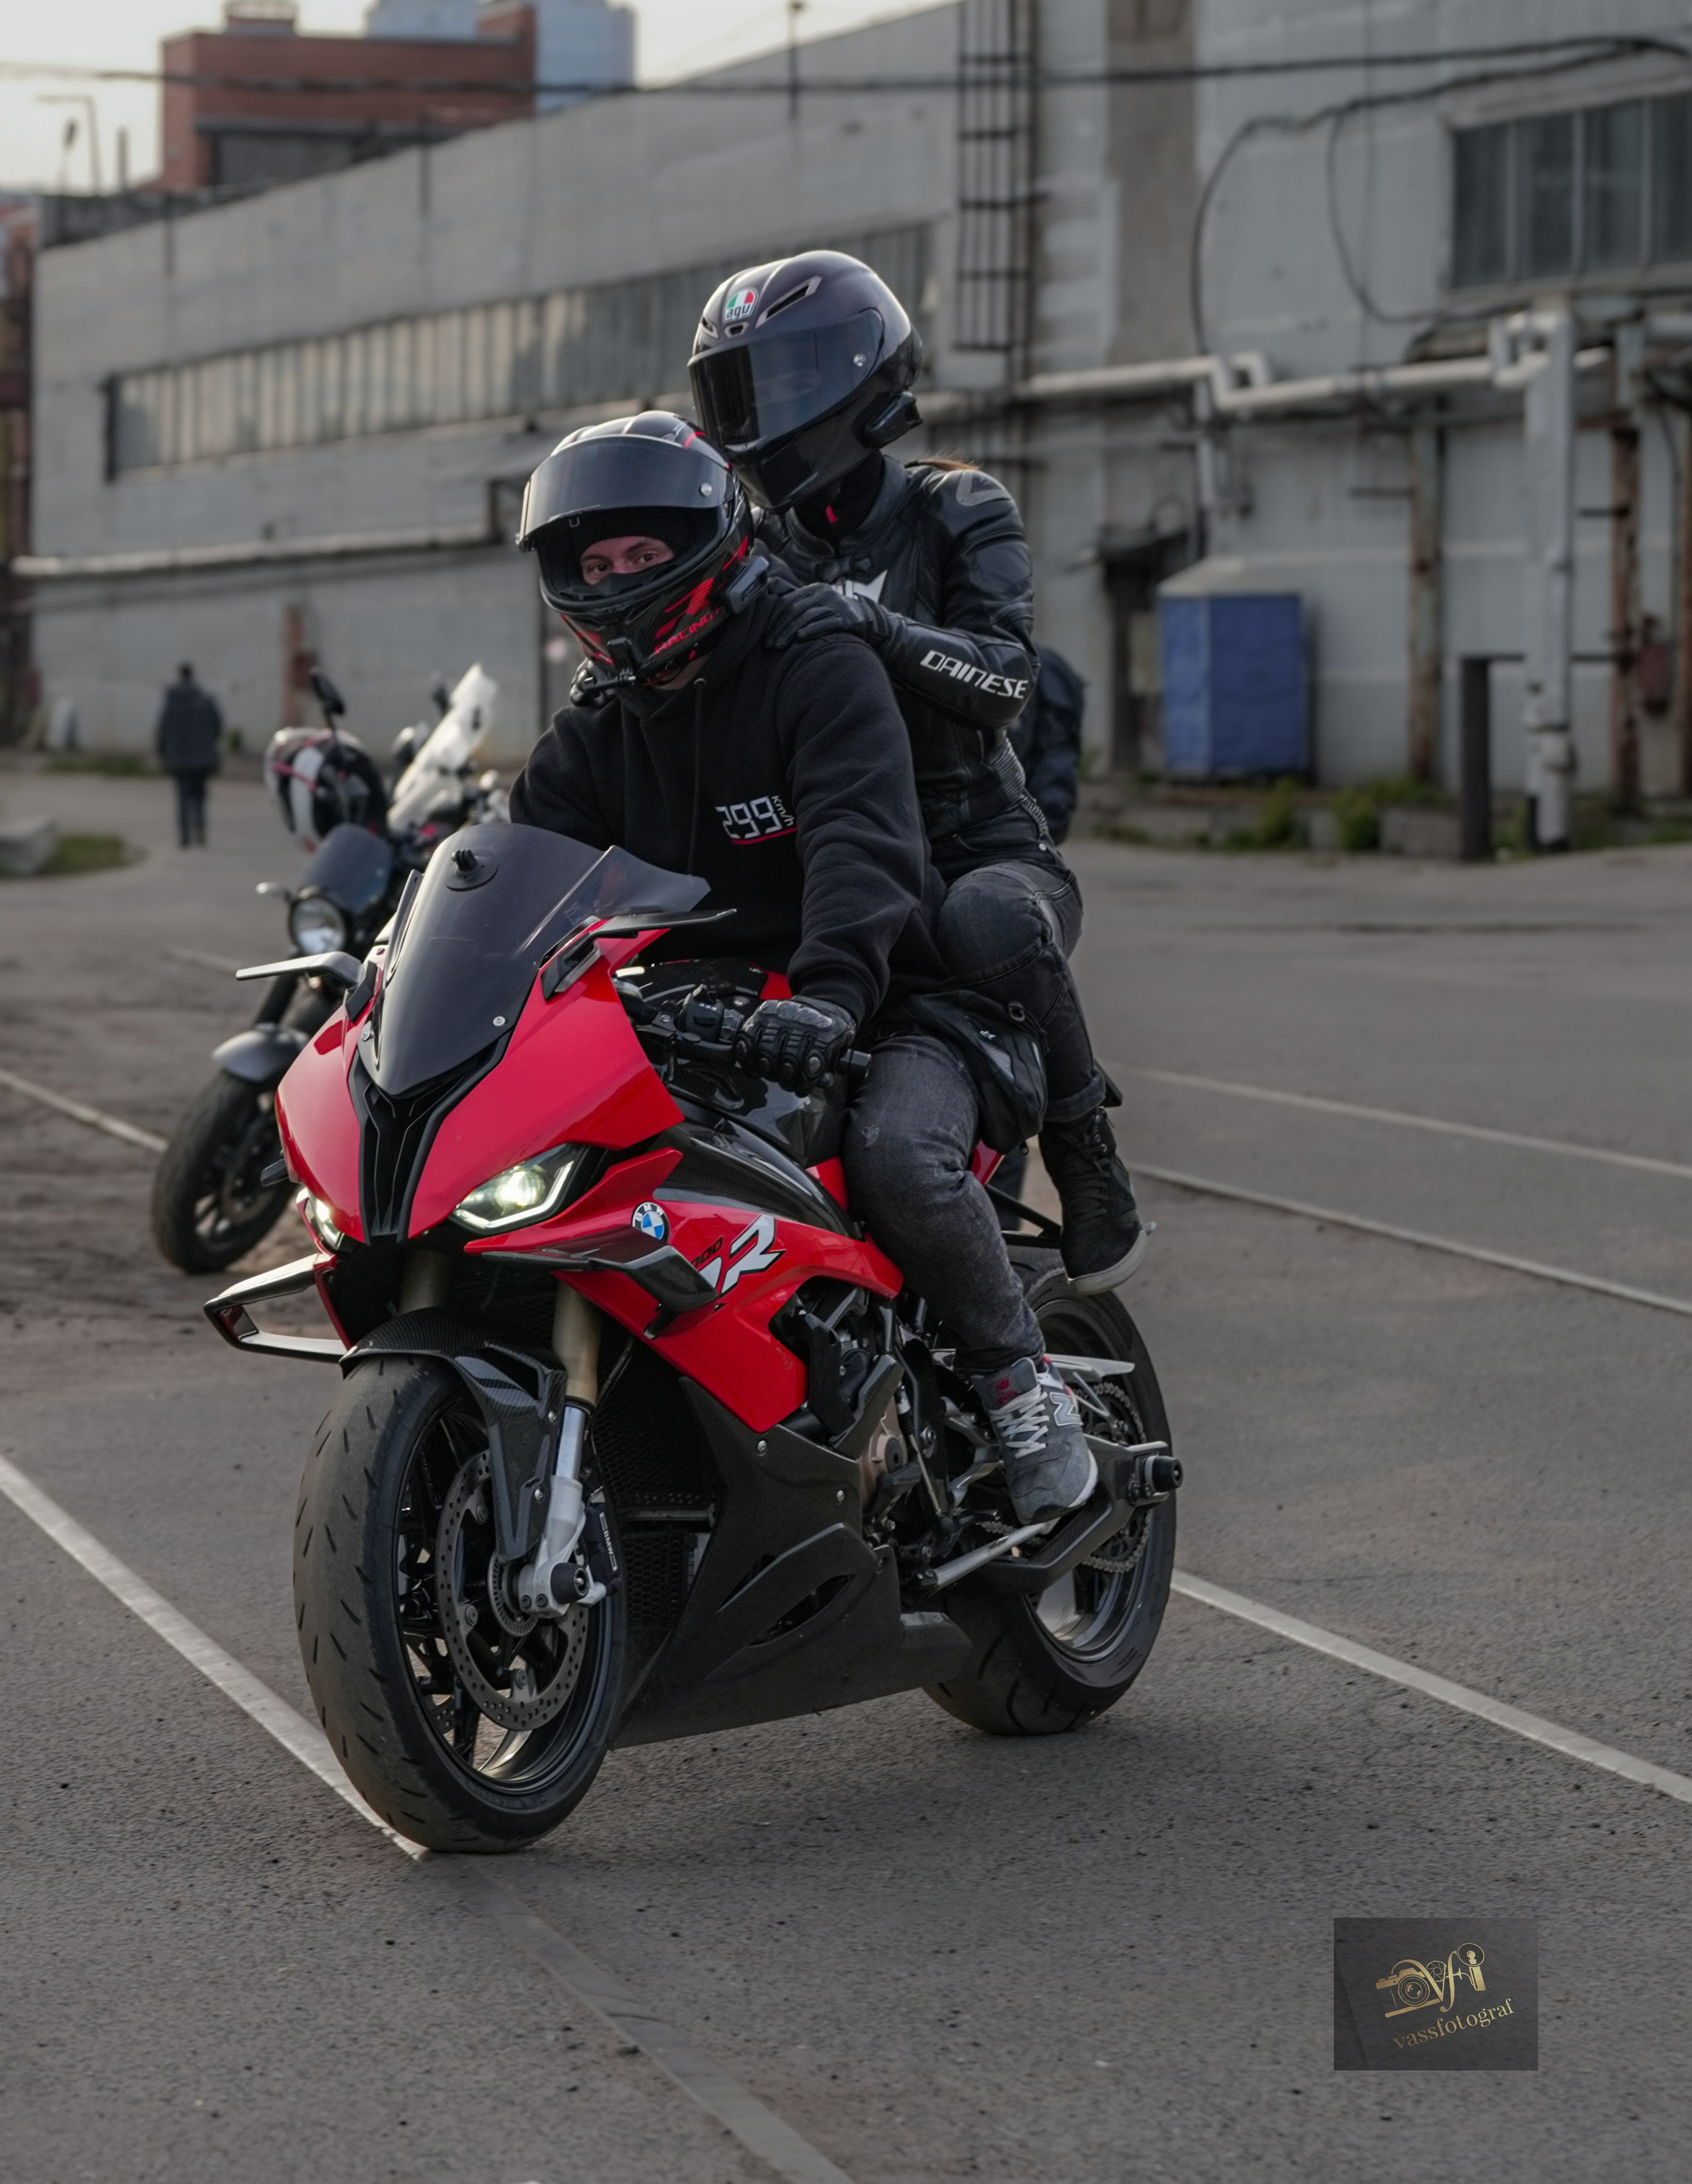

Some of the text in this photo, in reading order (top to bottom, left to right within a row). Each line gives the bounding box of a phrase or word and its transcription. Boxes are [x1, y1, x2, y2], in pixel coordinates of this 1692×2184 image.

[920, 650, 1028, 699] DAINESE
[715, 796, 794, 839] 299 km/h
[635, 1203, 664, 1222] BMW
[603, 1529, 614, 1555] BMW
